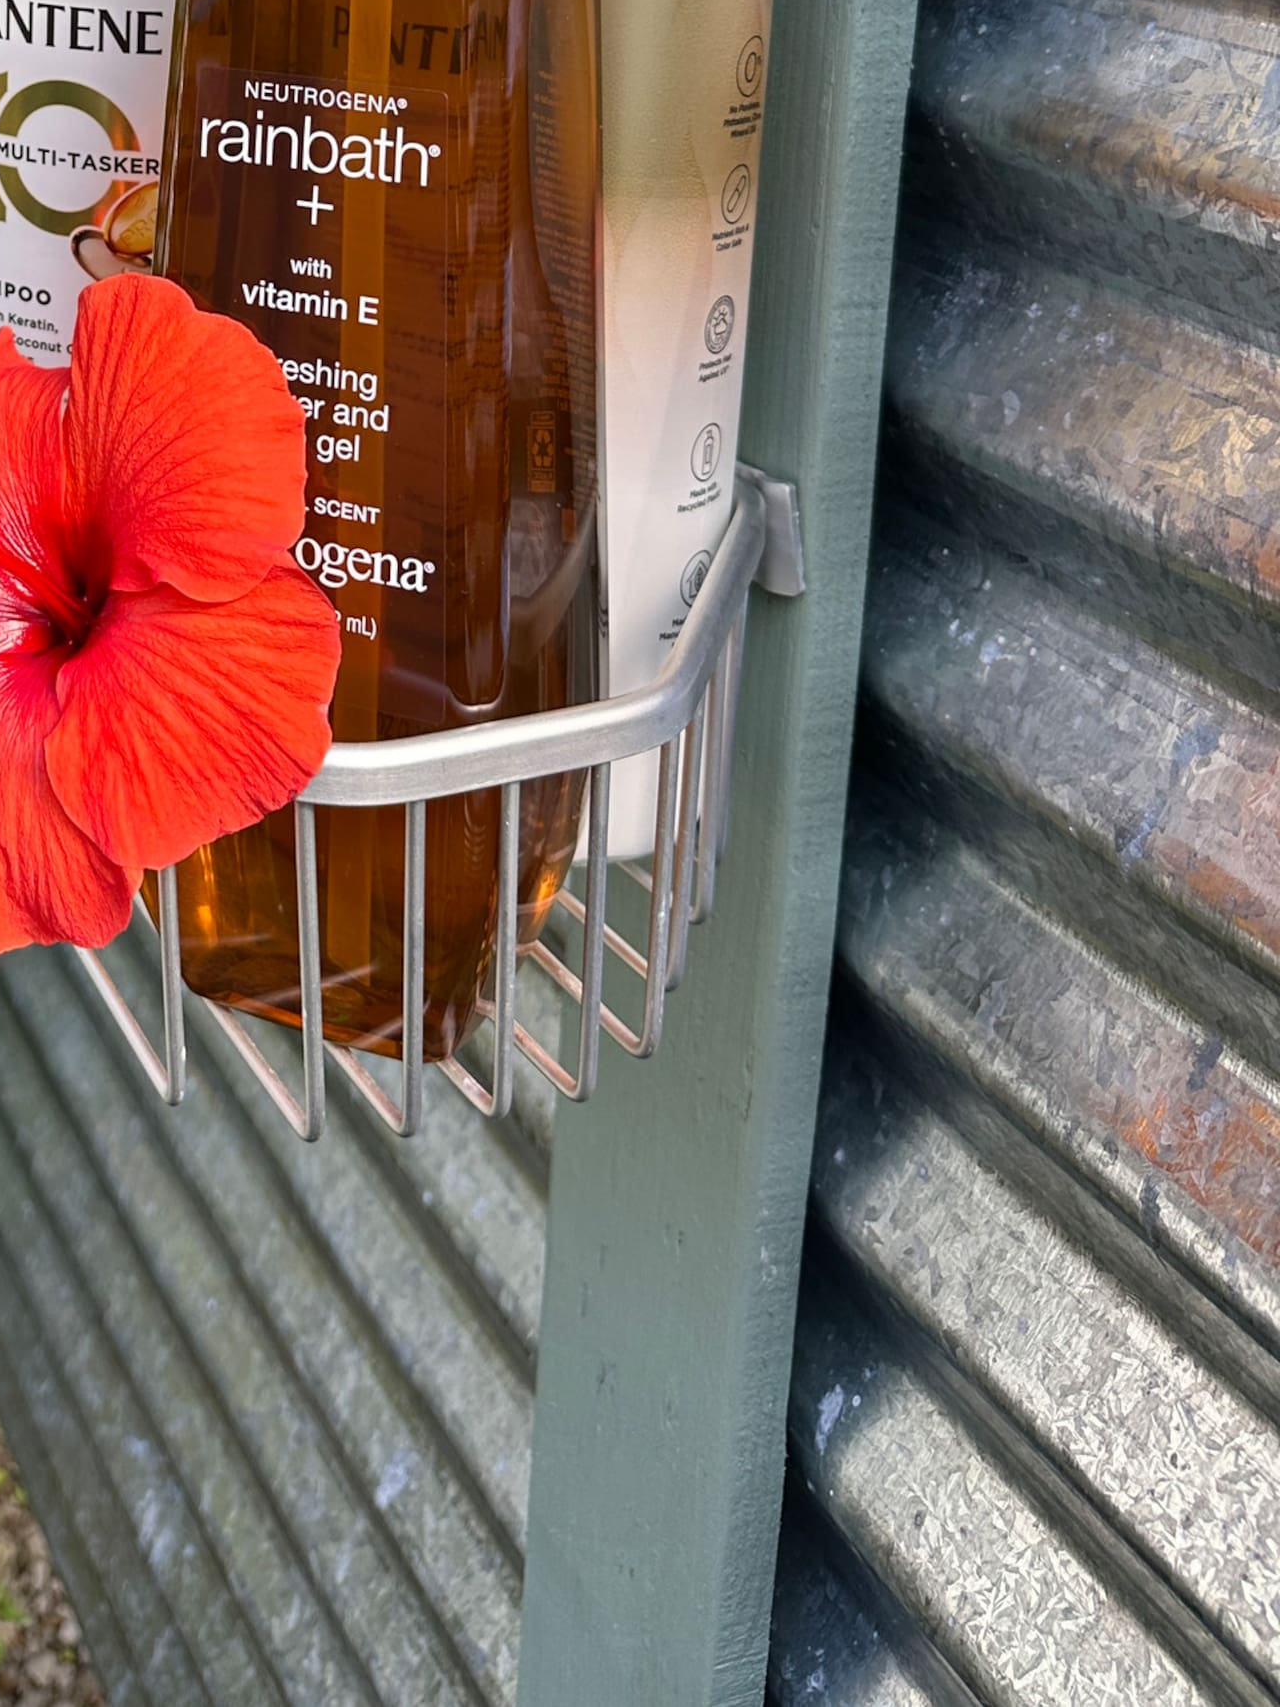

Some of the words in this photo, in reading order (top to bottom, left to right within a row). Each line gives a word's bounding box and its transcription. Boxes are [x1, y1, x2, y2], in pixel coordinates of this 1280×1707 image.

[290, 257, 332, 279] with
[242, 280, 348, 321] vitamin
[358, 296, 379, 325] E
[8, 312, 59, 334] Keratin,
[13, 334, 61, 353] oconut
[278, 358, 378, 401] eshing
[332, 403, 390, 432] and
[316, 434, 360, 463] gel
[314, 497, 381, 525] SCENT
[346, 615, 377, 640] mL)
